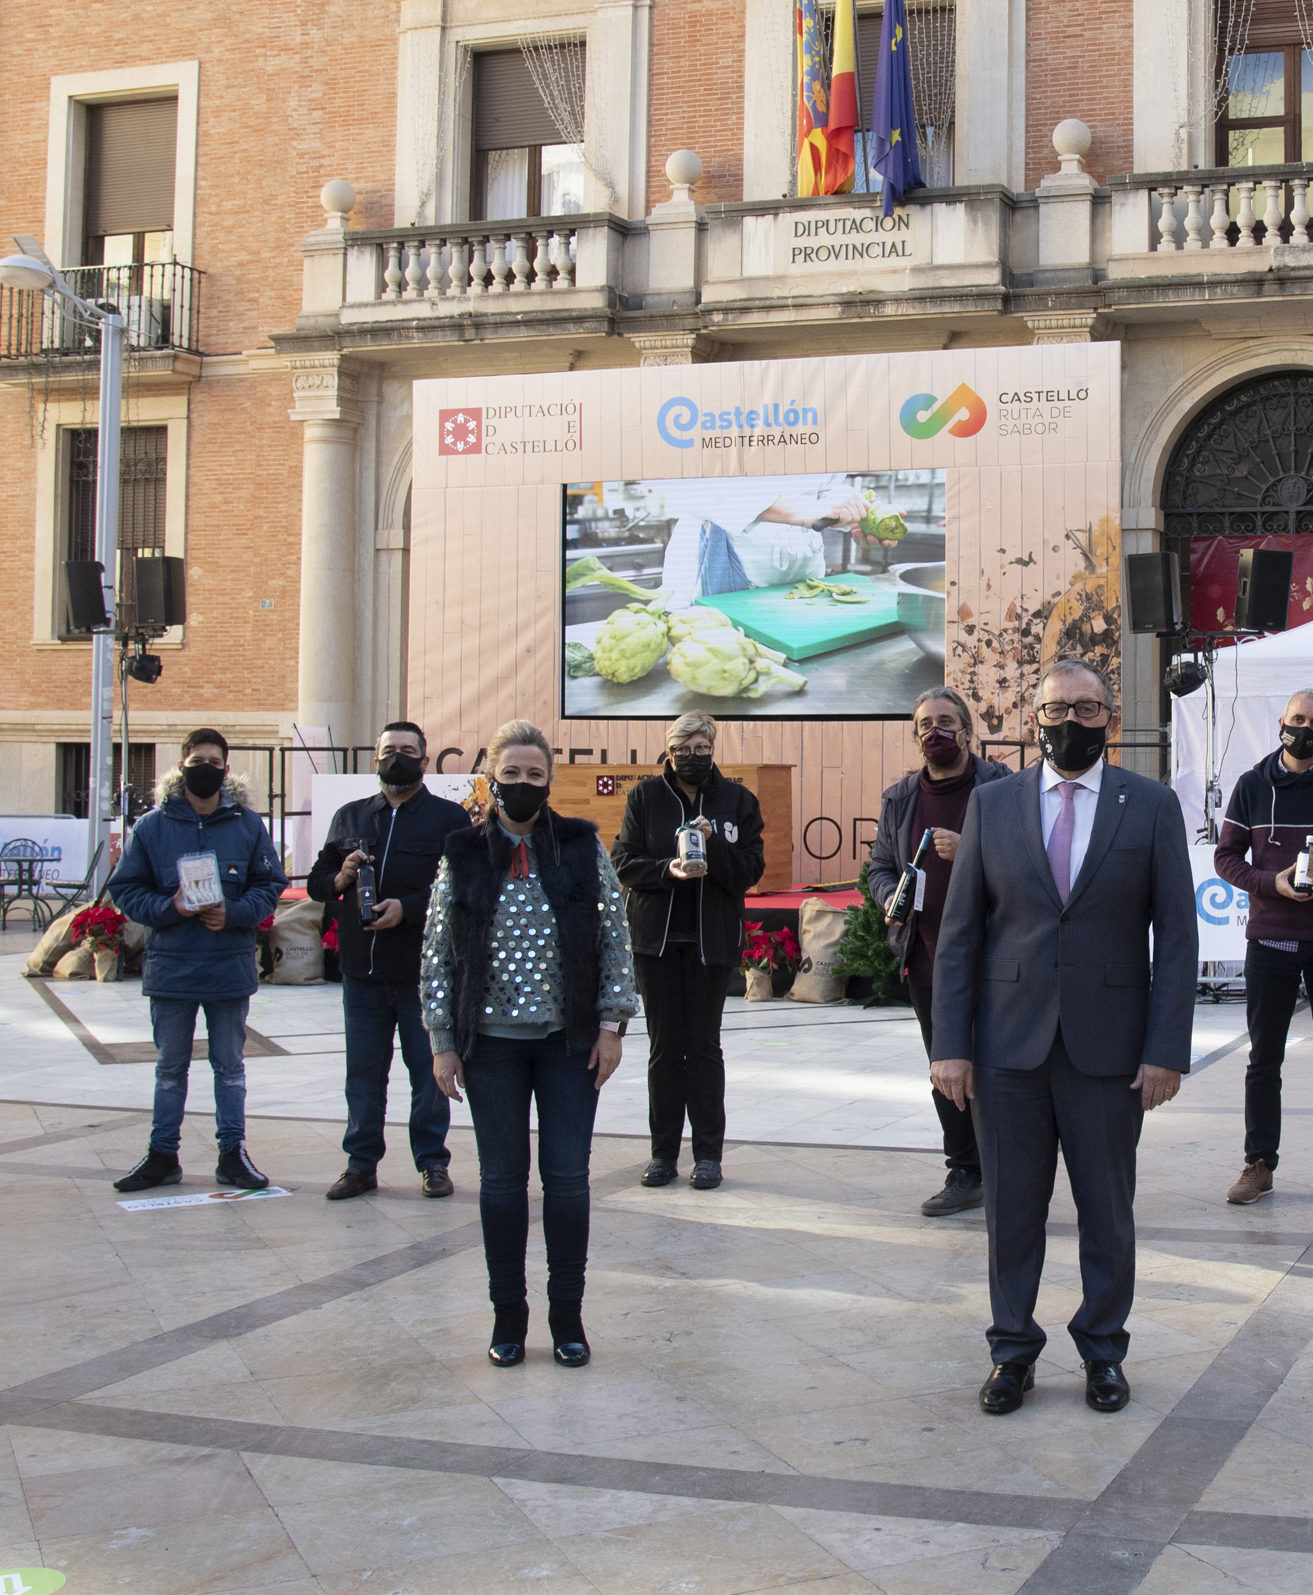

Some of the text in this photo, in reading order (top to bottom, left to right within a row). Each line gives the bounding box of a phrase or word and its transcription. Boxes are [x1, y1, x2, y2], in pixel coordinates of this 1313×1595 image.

[791, 240, 912, 264] PROVINCIAL
[485, 399, 577, 420] DIPUTACIÓ
[999, 405, 1072, 421] RUTA DE
[485, 420, 577, 438] D E
[999, 421, 1059, 437] SABOR
[484, 435, 577, 456] CASTELLÓ
[701, 431, 820, 449] MEDITERRÁNEO
